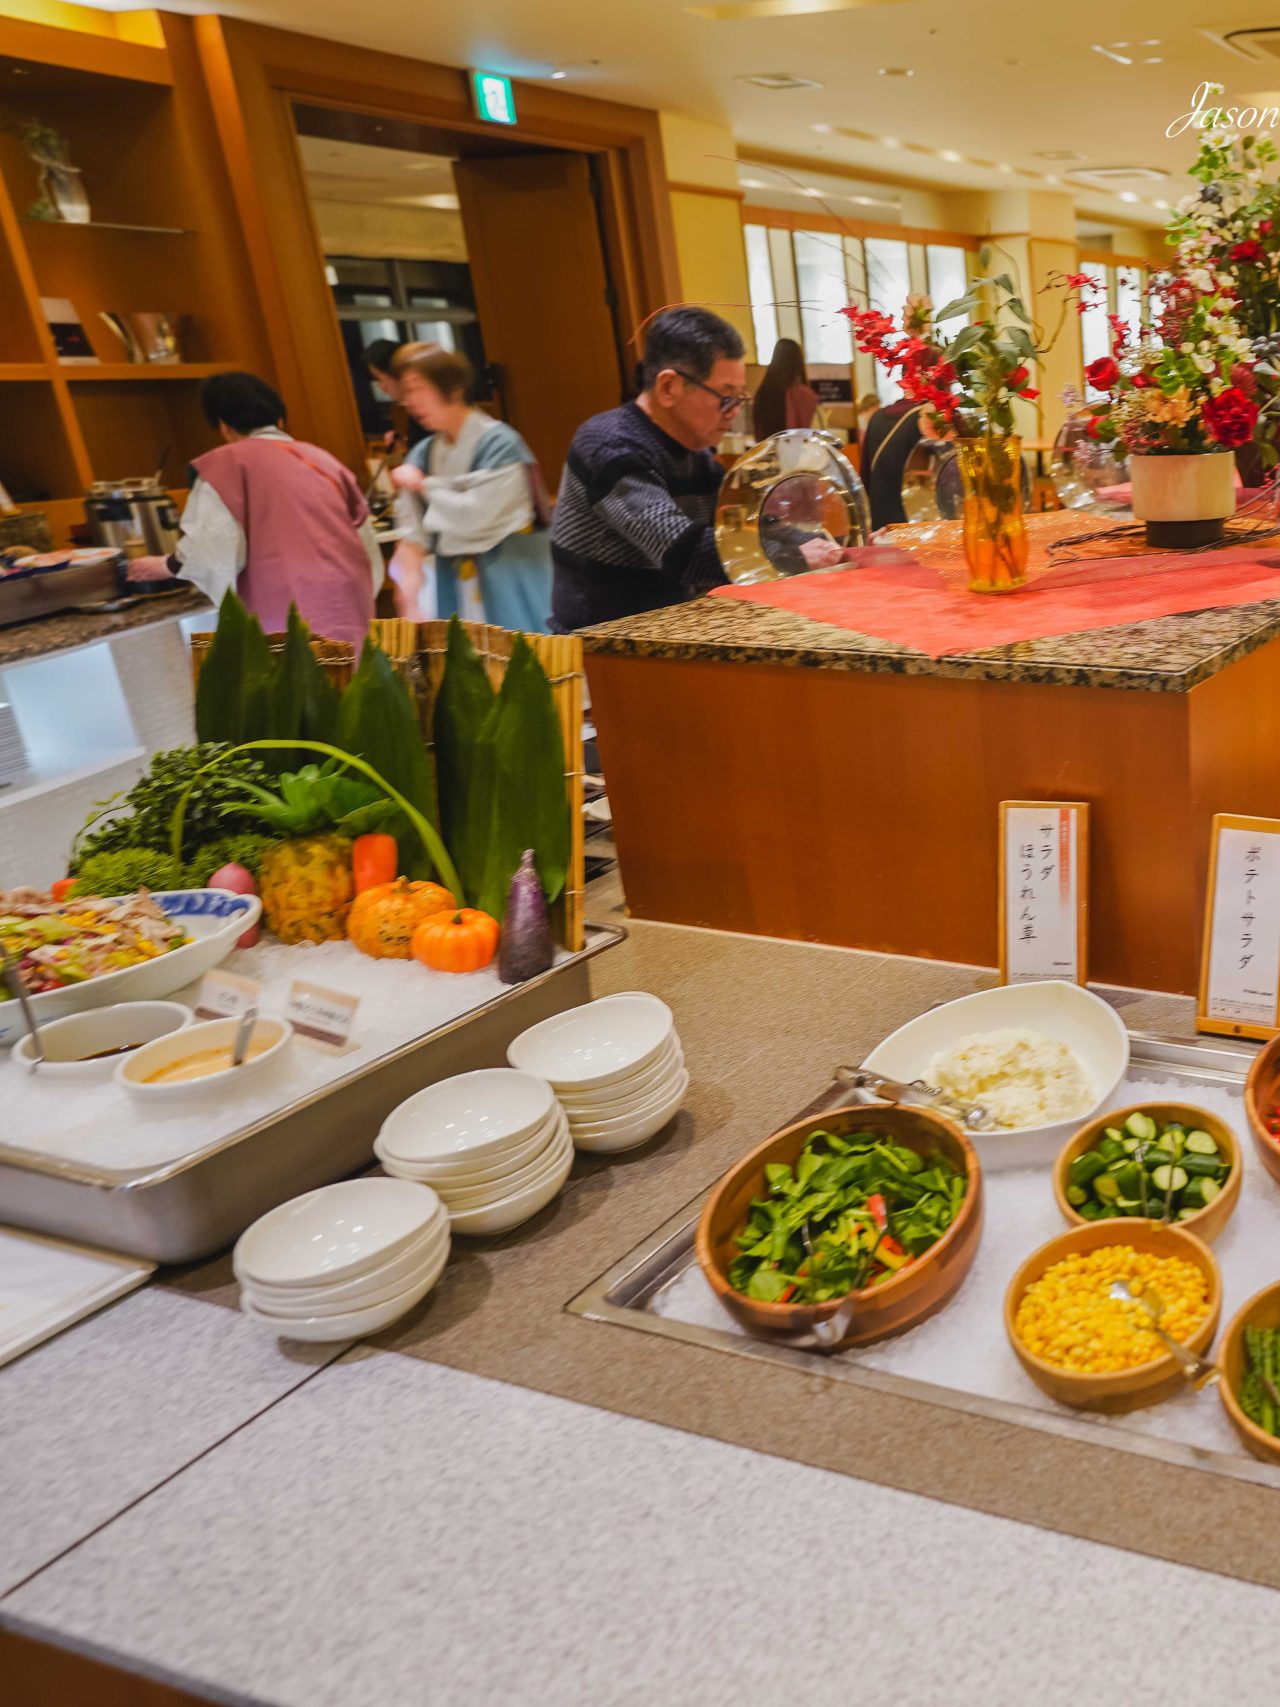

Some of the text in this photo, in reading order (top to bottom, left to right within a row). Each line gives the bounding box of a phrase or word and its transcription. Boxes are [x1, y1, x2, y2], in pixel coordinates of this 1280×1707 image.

[1018, 844, 1037, 944] ほうれん草
[1039, 824, 1055, 881] サラダ
[1239, 844, 1262, 969] ポテトサラダ
